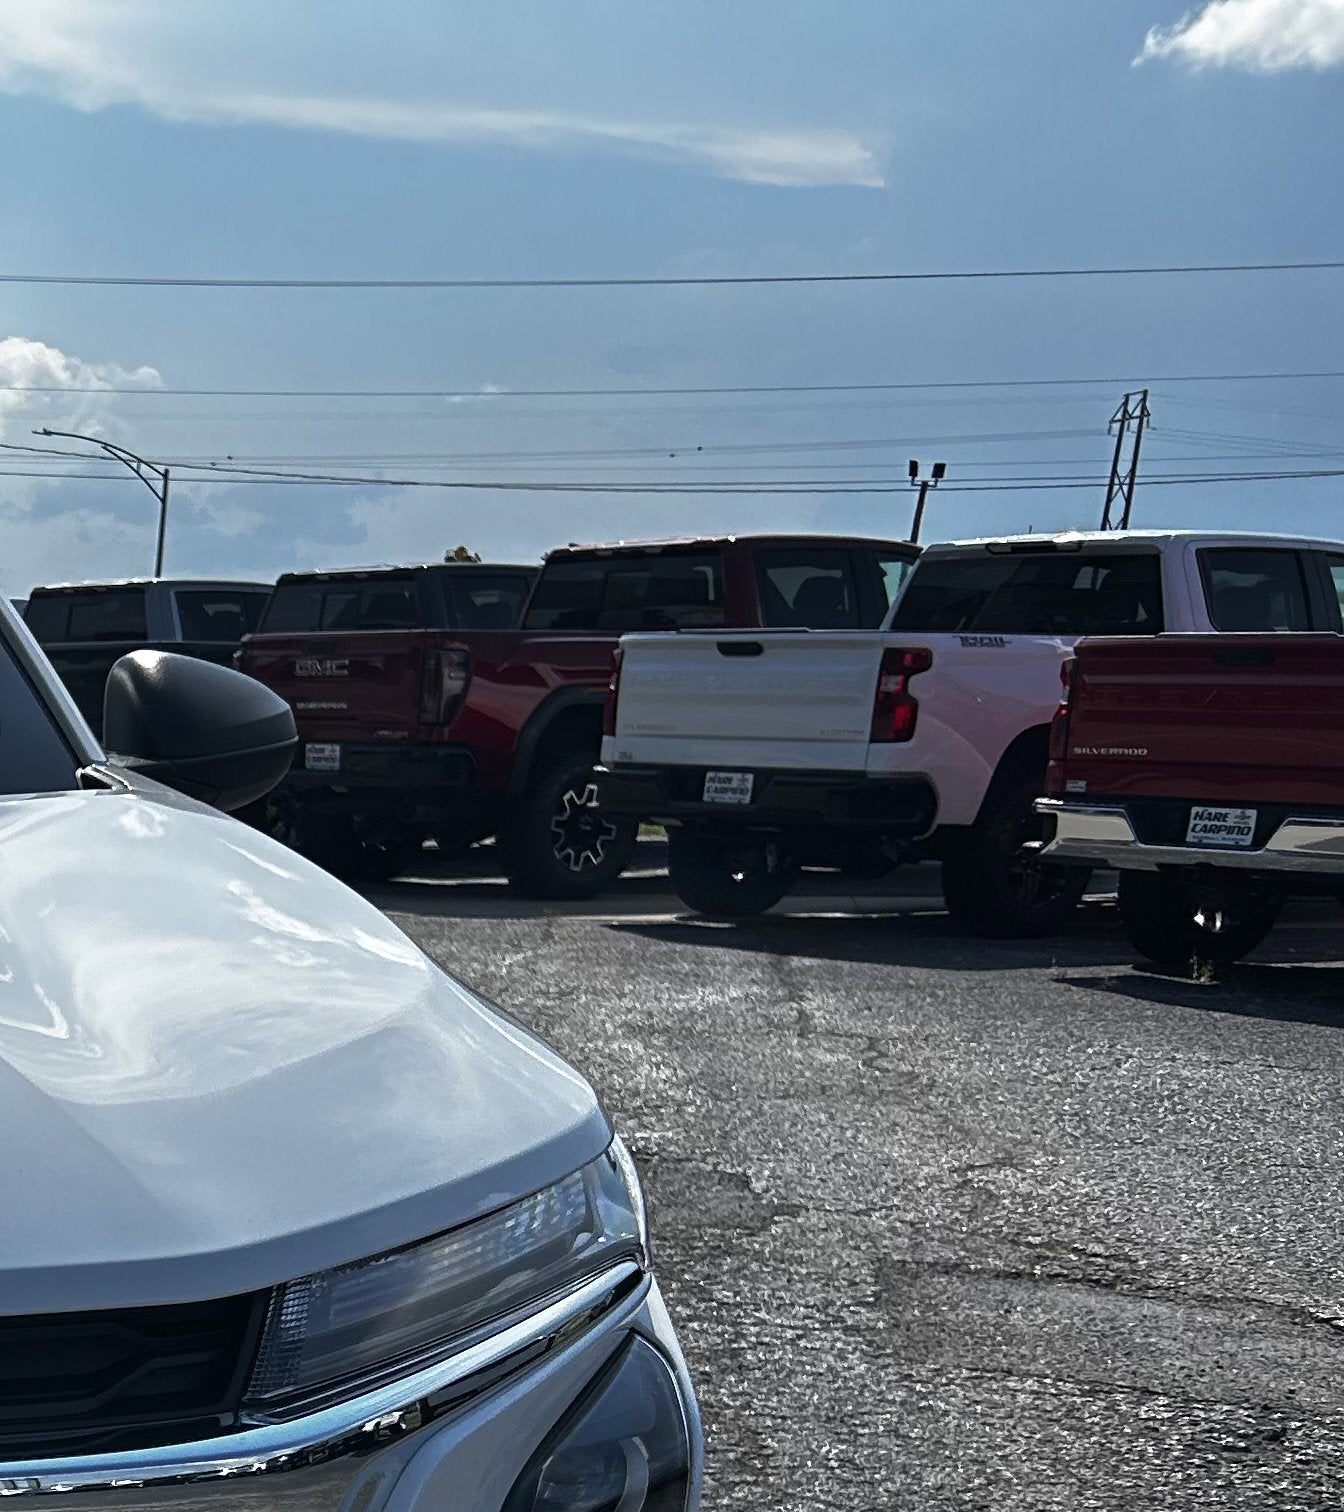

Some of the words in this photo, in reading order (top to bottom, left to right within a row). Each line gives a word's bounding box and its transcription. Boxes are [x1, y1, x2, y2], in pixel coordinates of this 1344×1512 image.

[295, 659, 350, 677] GMC
[1073, 746, 1149, 757] SILVERADO
[1193, 810, 1231, 823] HARE
[1191, 823, 1252, 836] CARPINO
